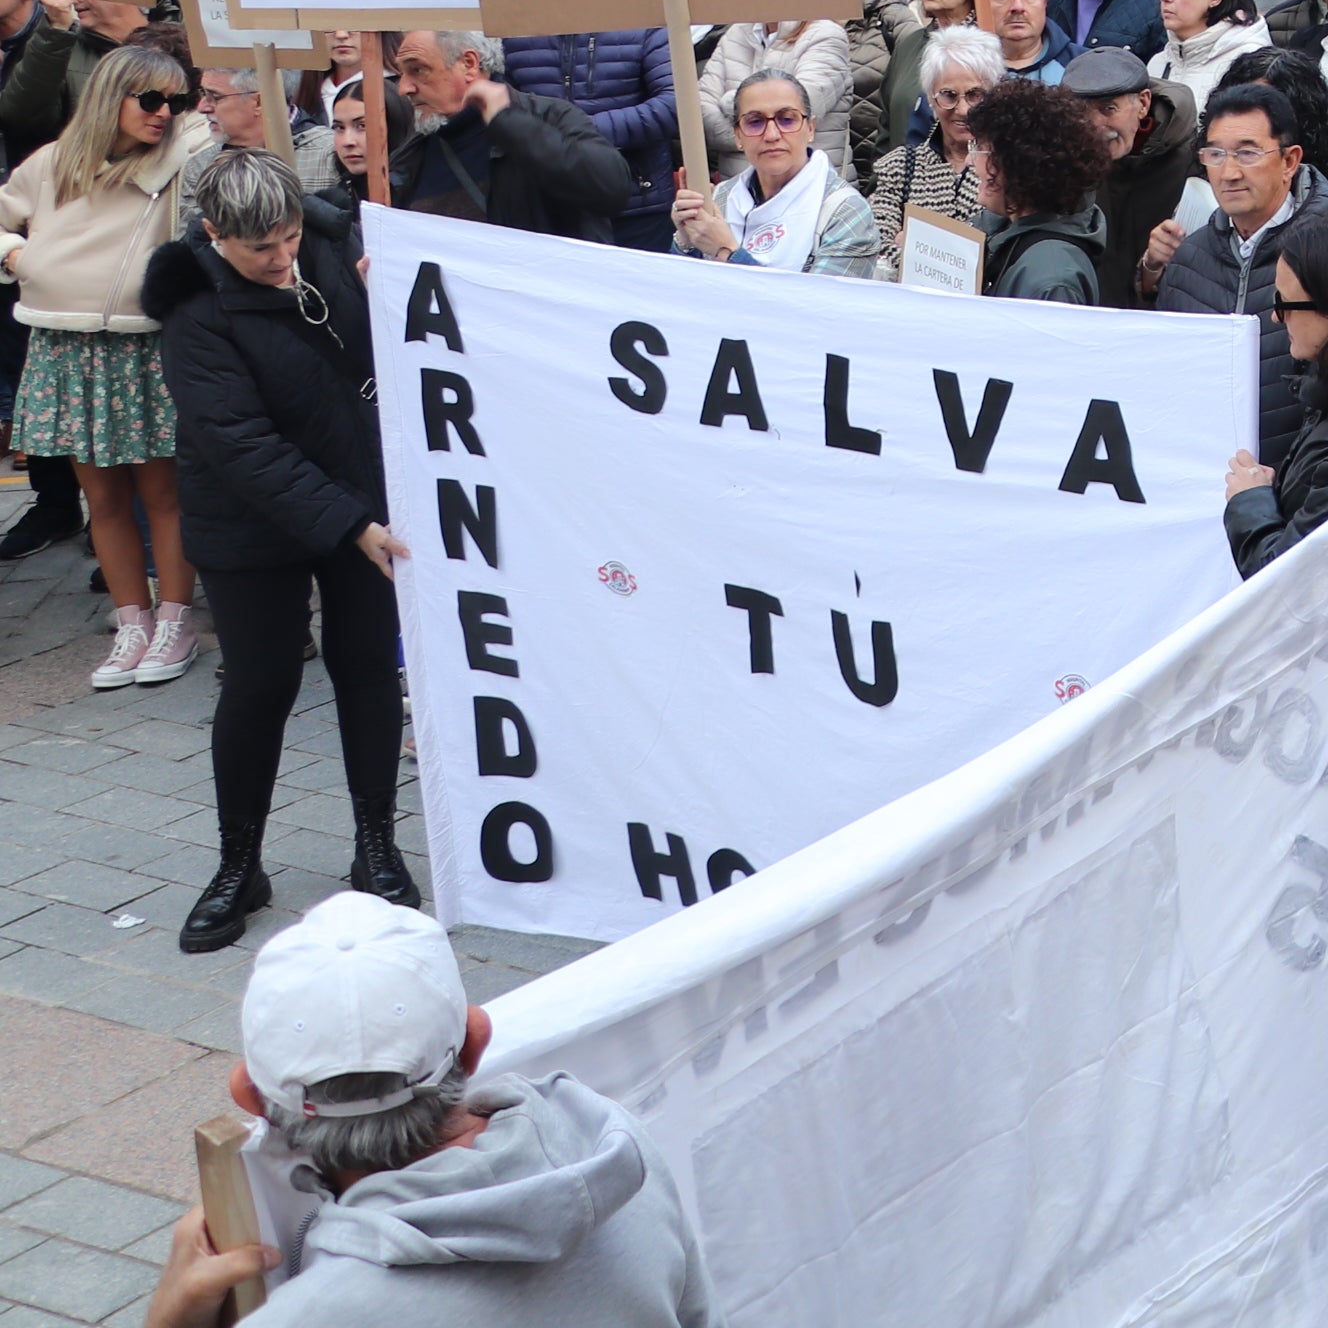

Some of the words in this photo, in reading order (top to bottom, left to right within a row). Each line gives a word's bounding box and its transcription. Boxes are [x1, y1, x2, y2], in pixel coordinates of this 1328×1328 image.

[914, 240, 929, 255] POR
[930, 243, 967, 271] MANTENER
[914, 263, 923, 274] LA
[924, 265, 952, 286] CARTERA
[954, 277, 964, 291] DE
[607, 320, 1146, 504] SALVA
[404, 260, 555, 884] ARNEDO
